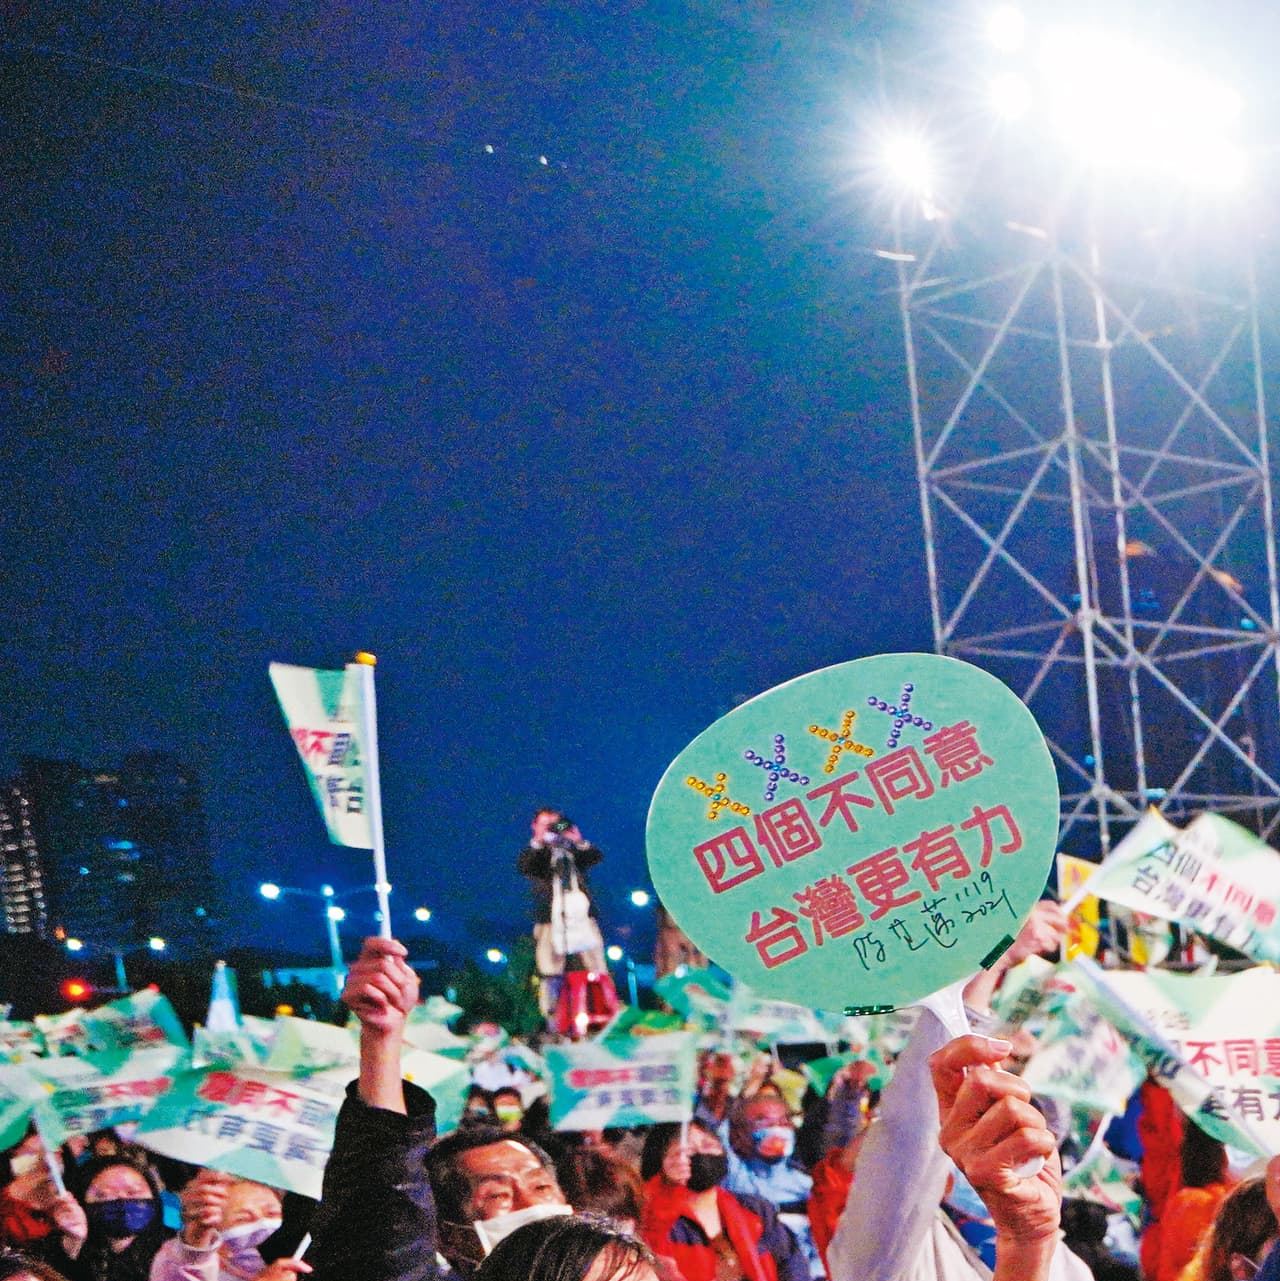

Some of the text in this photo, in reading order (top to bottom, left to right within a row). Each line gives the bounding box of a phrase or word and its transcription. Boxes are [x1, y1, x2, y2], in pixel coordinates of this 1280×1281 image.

[693, 719, 995, 894] 四個不同意
[744, 803, 1023, 969] 台灣更有力
